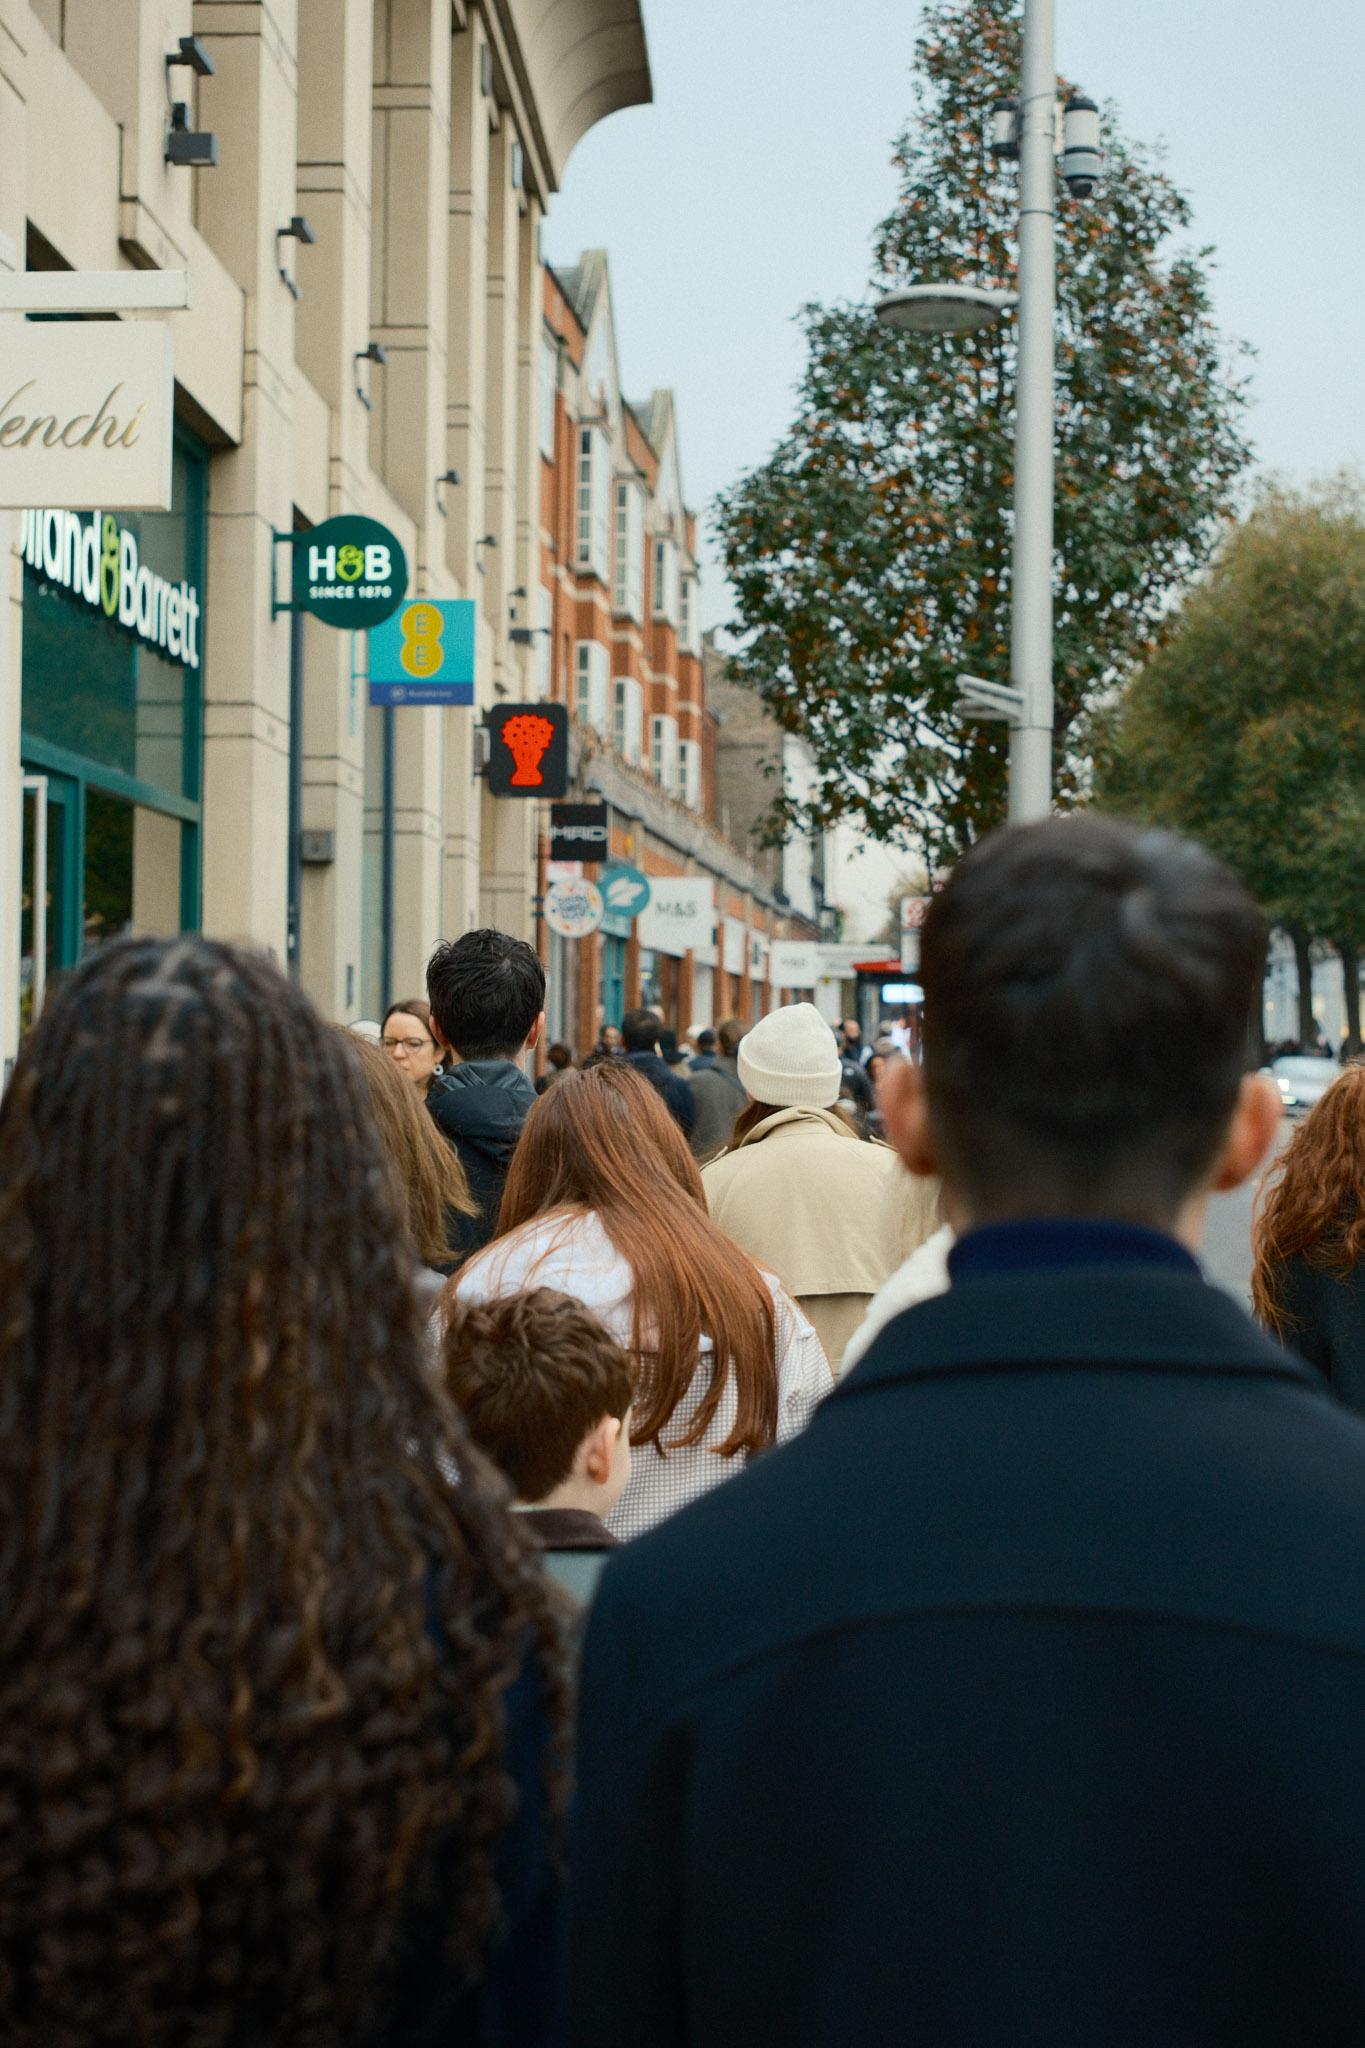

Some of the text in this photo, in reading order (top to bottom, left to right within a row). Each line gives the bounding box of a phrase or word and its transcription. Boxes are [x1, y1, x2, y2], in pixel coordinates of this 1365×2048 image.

[309, 544, 392, 582] H&B
[309, 586, 392, 599] SINCE 1870
[656, 900, 697, 918] M&S
